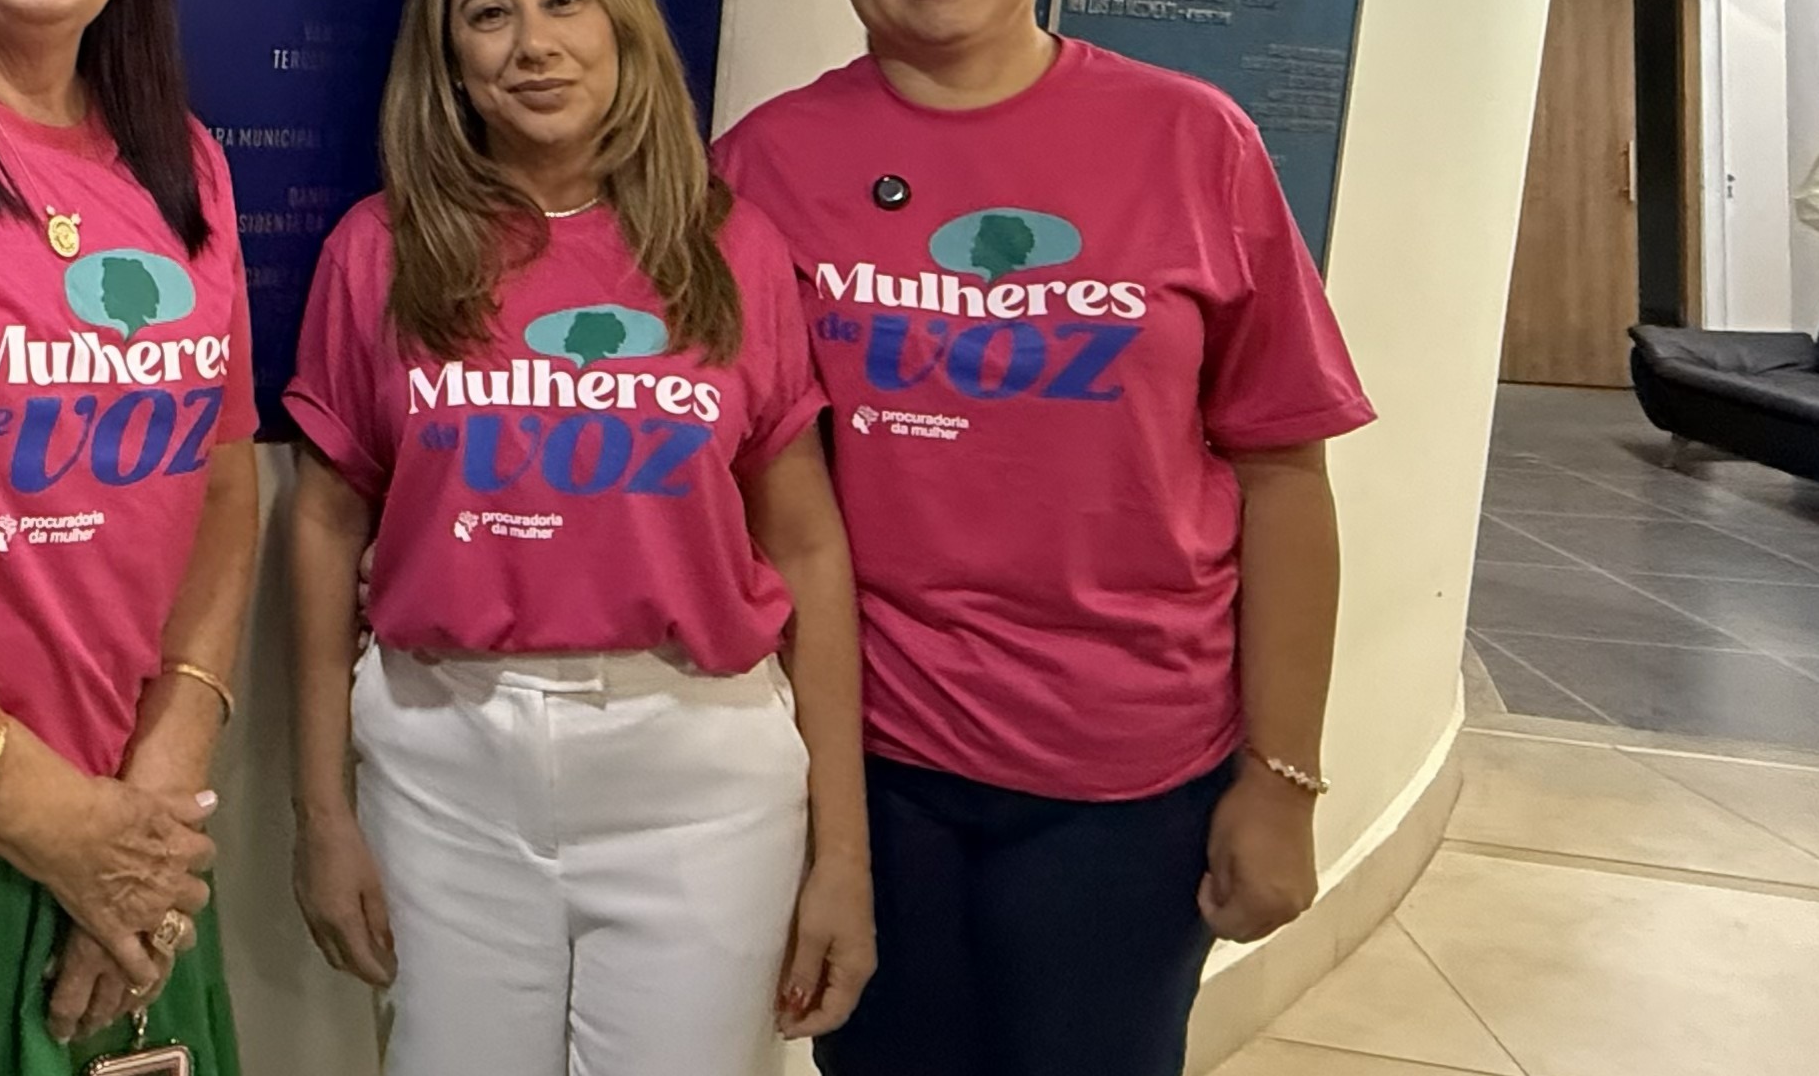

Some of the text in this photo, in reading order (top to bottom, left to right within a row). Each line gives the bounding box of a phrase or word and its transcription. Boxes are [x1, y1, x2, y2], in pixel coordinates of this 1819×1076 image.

[816, 262, 1146, 319] Mulheres
[408, 359, 721, 422] Mulheres
[882, 409, 969, 430] procuradoria
[891, 423, 959, 440] da mulher
[20, 511, 104, 533] procuradoria
[481, 511, 563, 528] procuradoria
[28, 527, 95, 544] da mulher
[491, 523, 553, 540] da mulher
